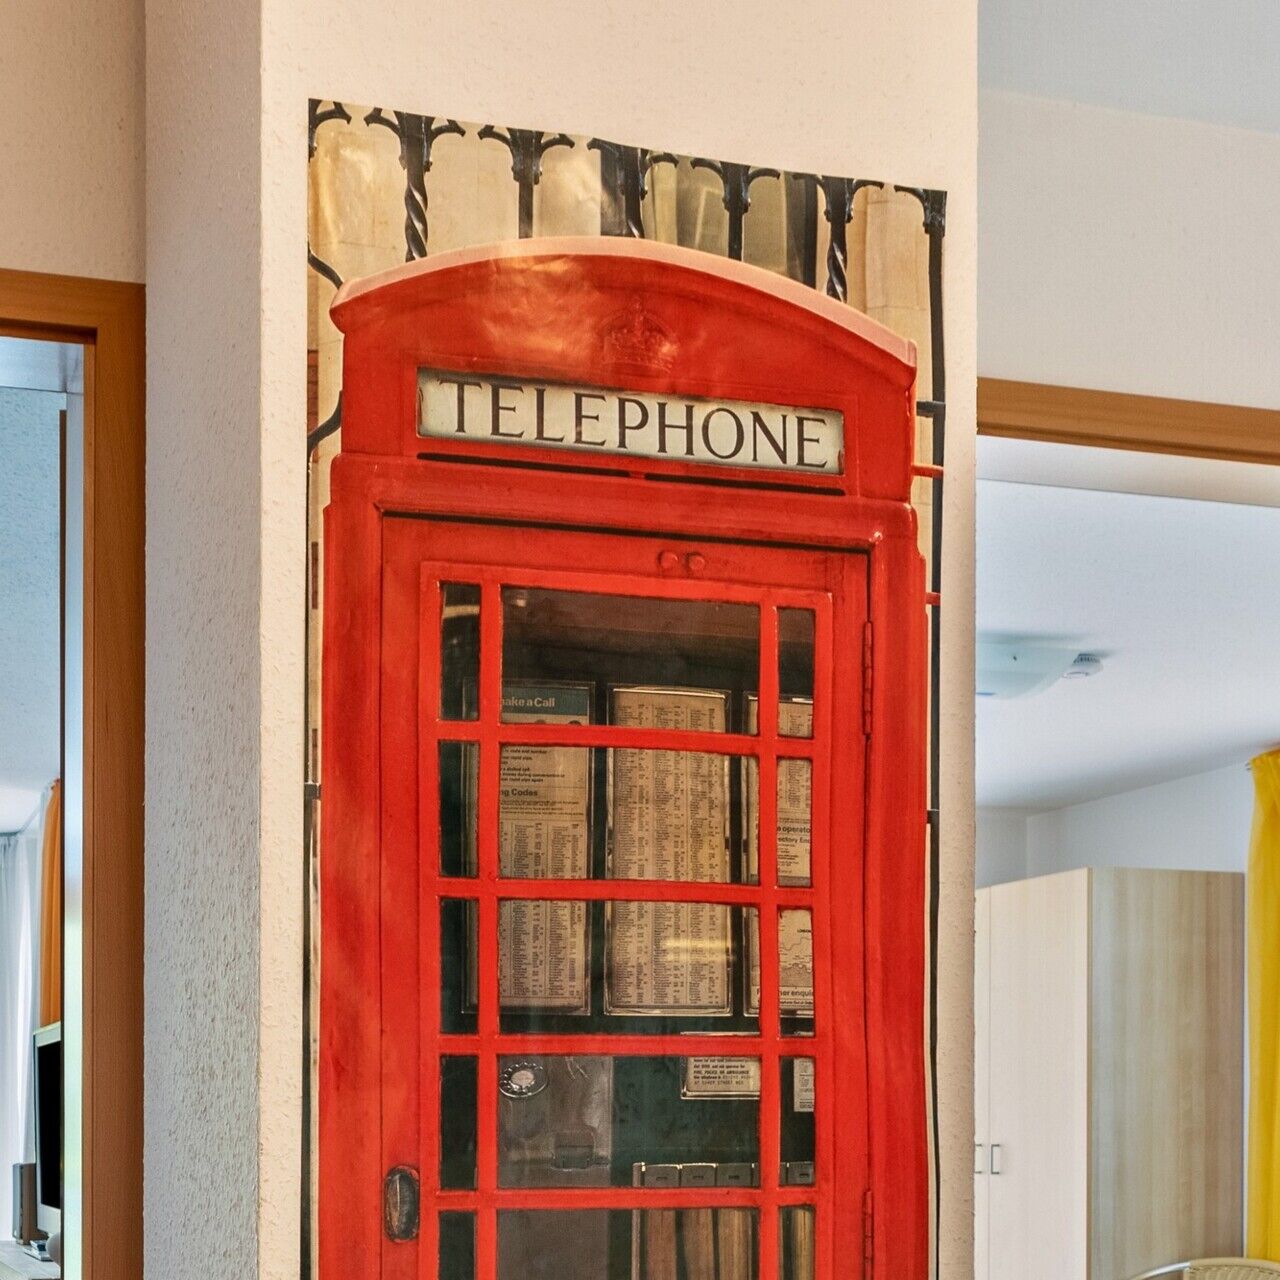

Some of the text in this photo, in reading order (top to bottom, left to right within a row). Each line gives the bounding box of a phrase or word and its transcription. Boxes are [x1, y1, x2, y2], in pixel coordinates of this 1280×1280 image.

[439, 378, 828, 469] TELEPHONE
[534, 697, 555, 707] Call
[512, 788, 538, 796] Codes
